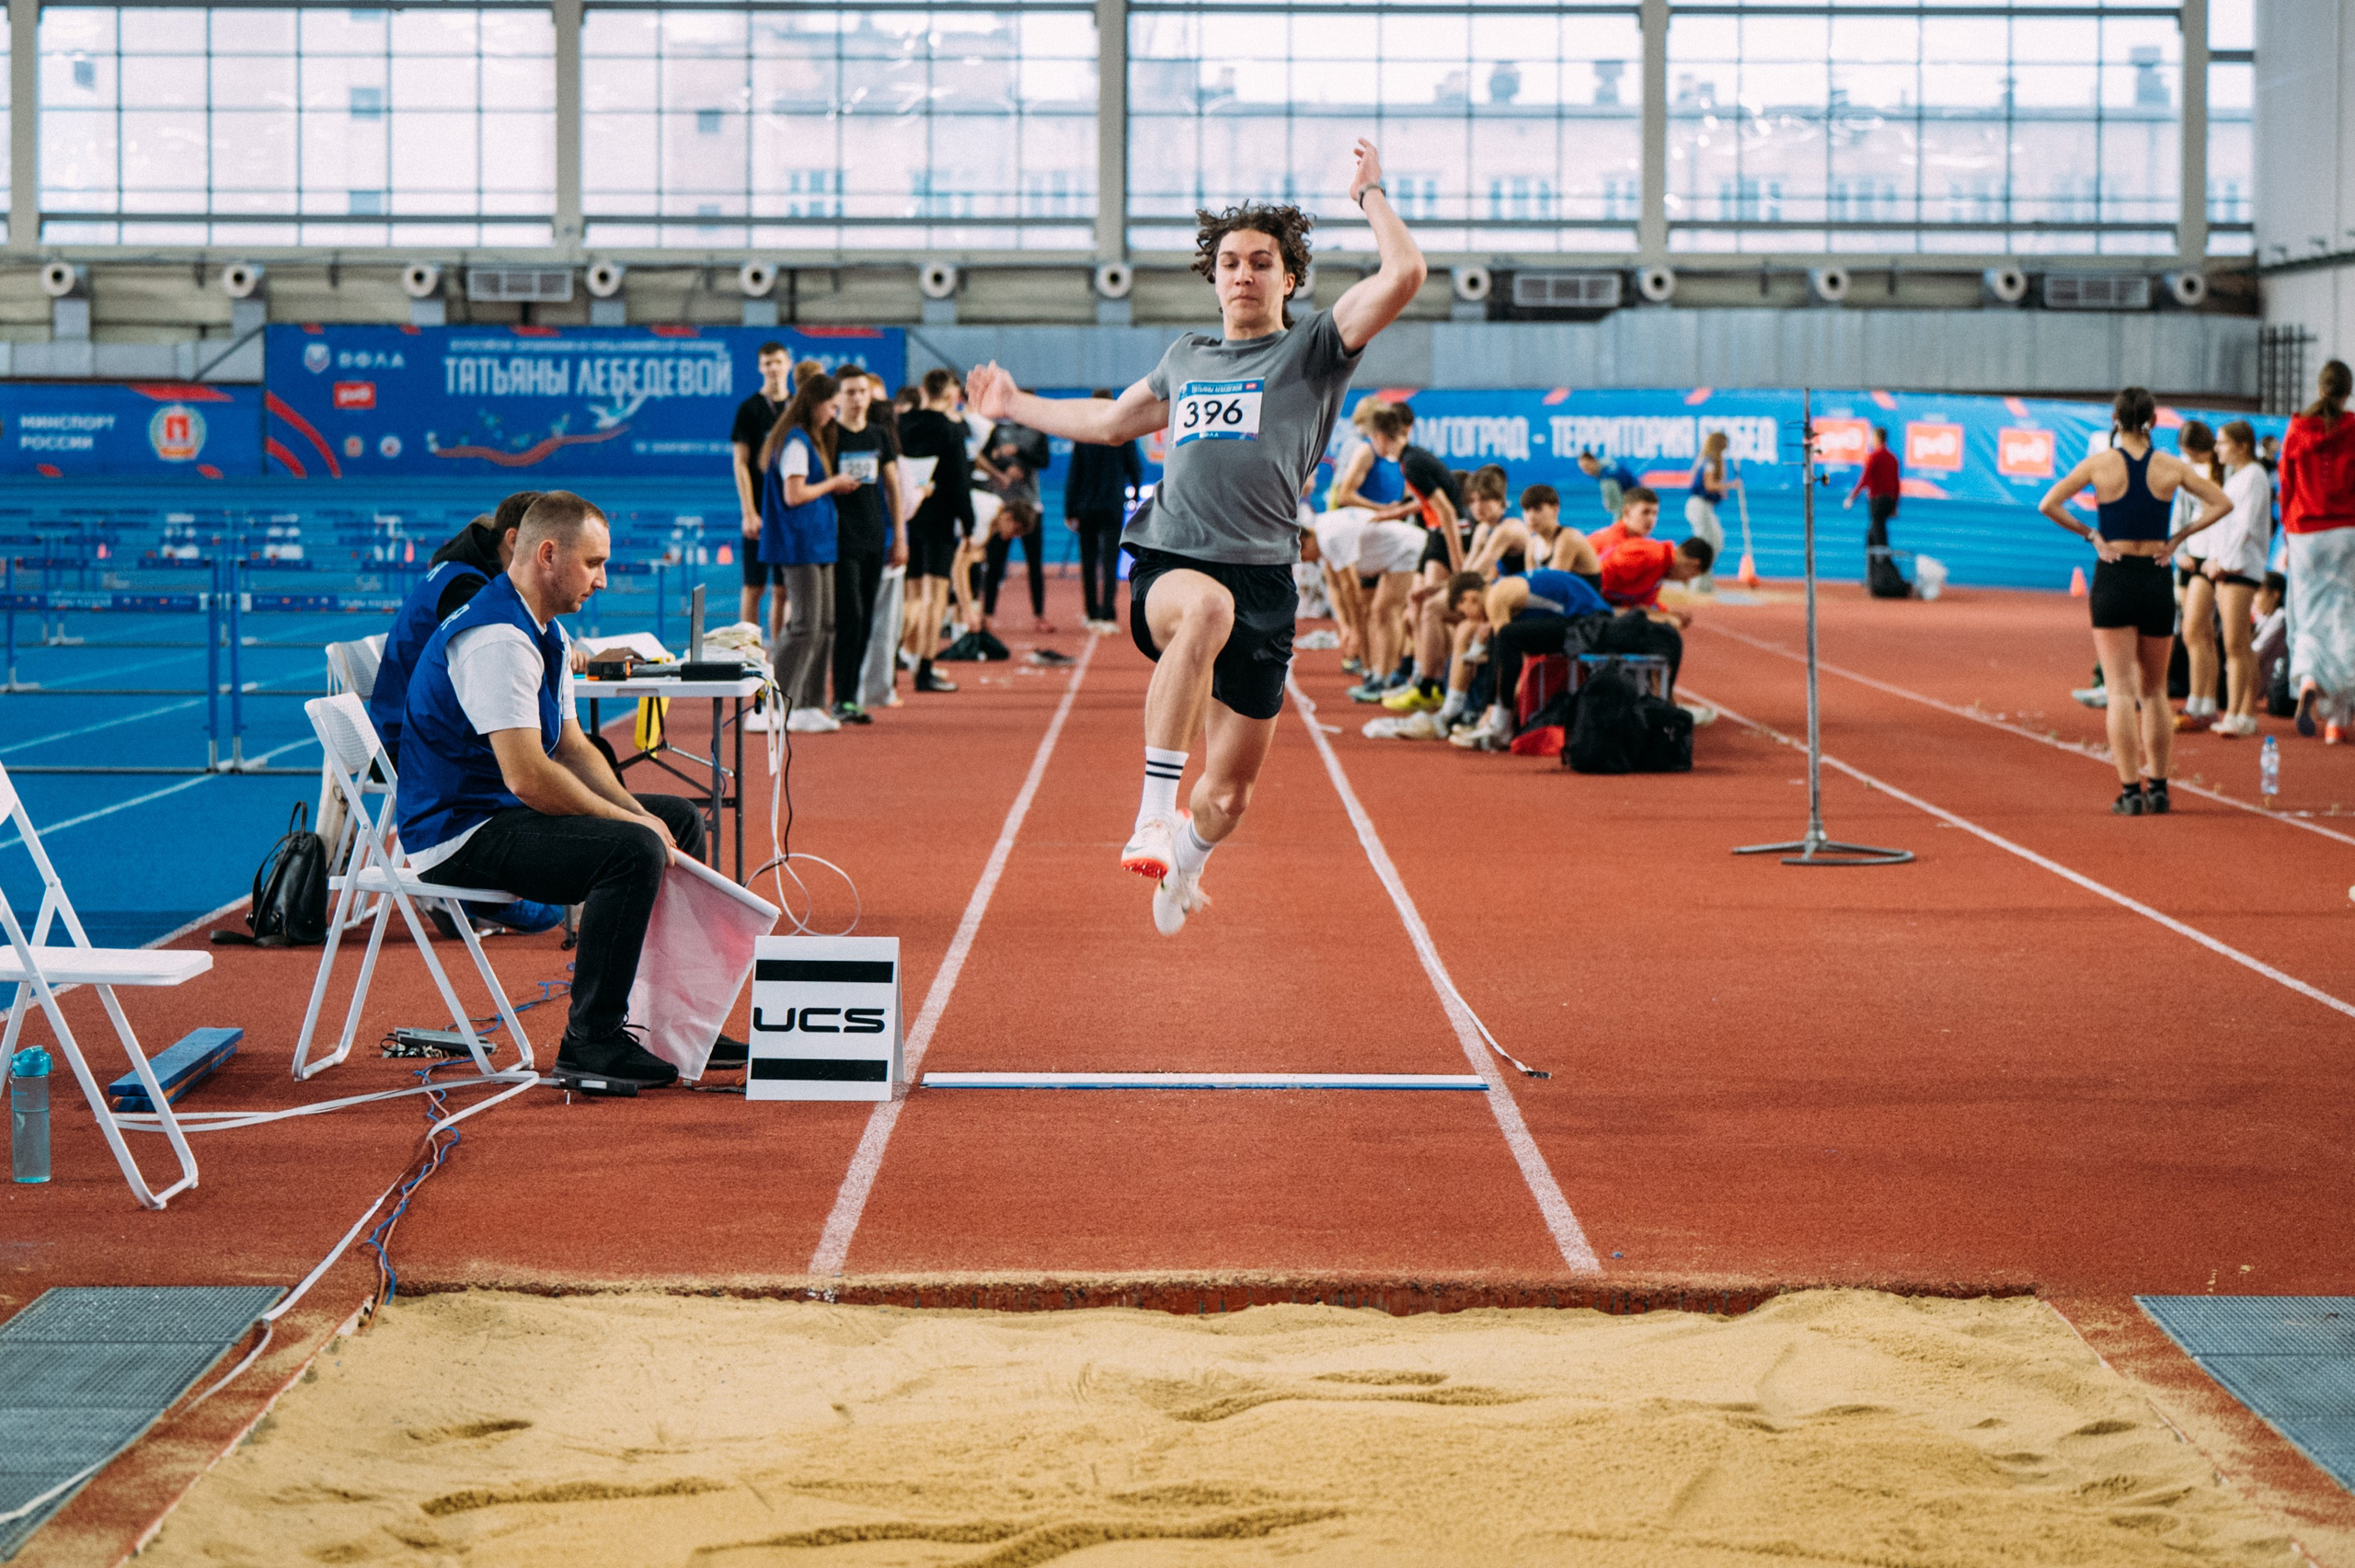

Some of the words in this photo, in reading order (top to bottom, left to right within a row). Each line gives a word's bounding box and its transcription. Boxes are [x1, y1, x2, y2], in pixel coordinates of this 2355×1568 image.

[445, 357, 569, 395] ТАТЬЯНЫ
[577, 353, 732, 399] ЛЕБЕДЕВОЙ
[19, 416, 115, 430] МИНСПОРТ
[1184, 399, 1243, 429] 396
[19, 435, 94, 450] РОССИИ
[1550, 416, 1695, 459] ТЕРРИТОРИЯ
[753, 1007, 885, 1034] UCS
